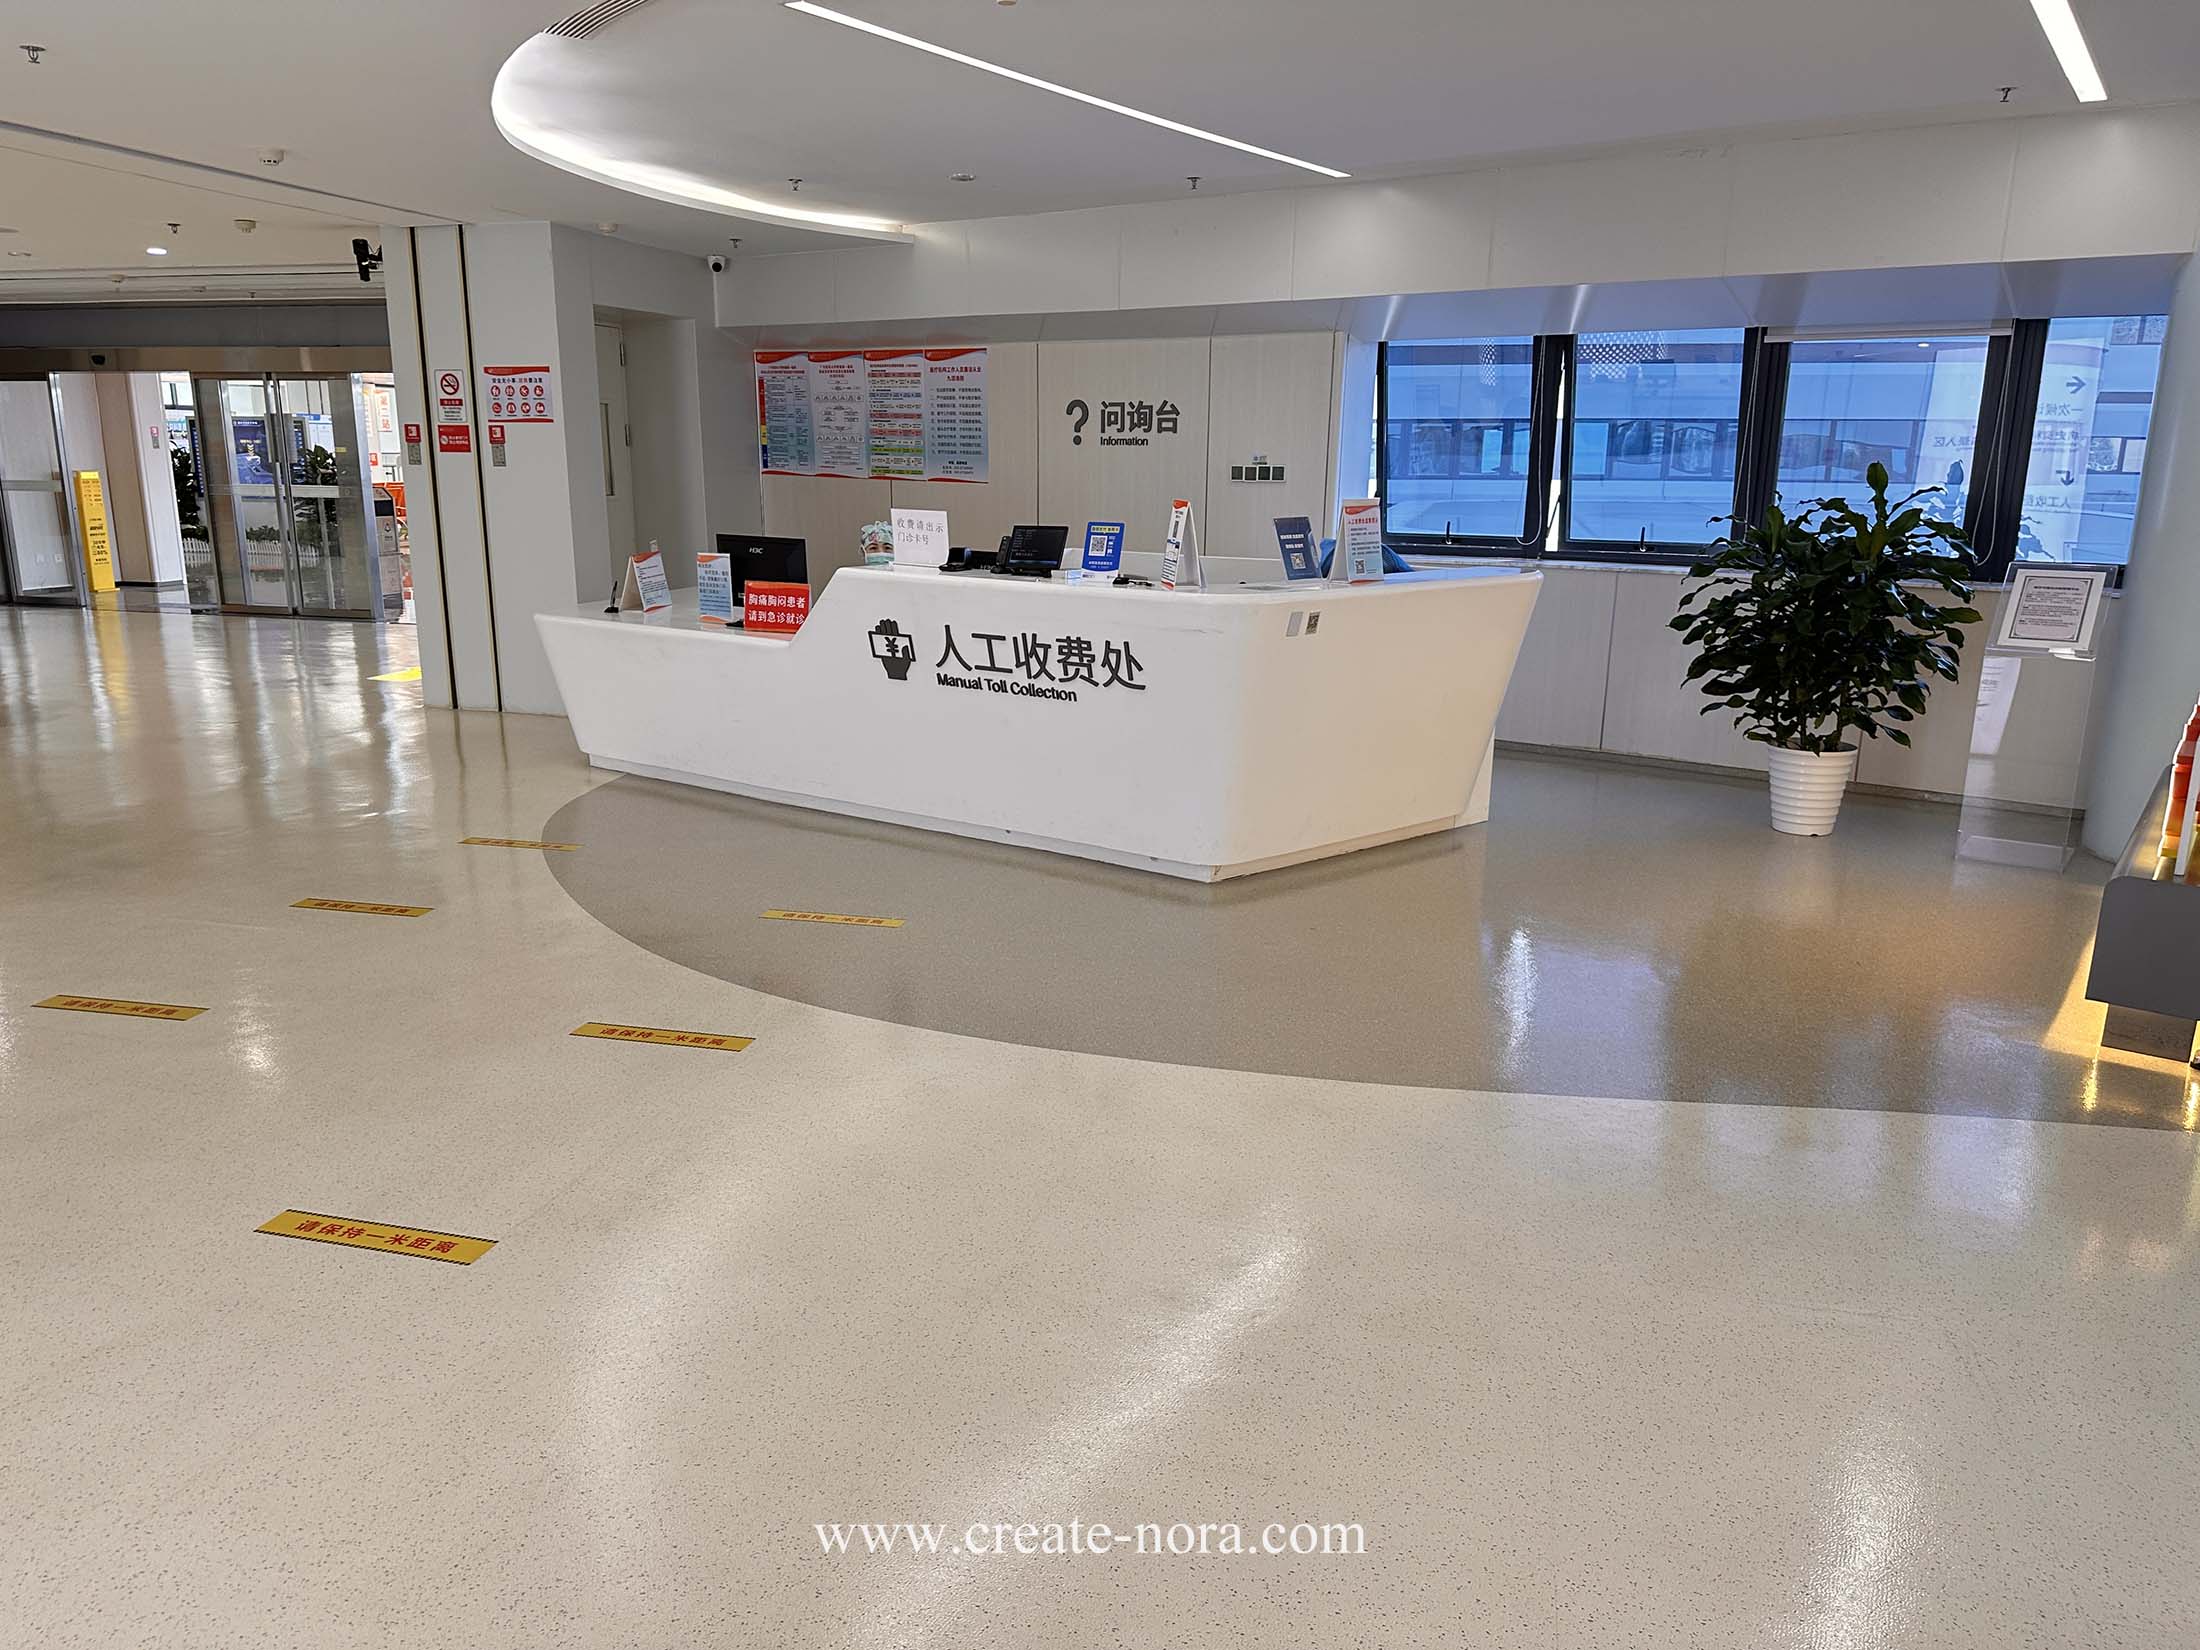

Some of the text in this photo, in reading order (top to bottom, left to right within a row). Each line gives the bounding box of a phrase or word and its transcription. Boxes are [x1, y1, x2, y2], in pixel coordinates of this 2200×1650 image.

[1100, 400, 1180, 434] 问询台
[1100, 436, 1149, 446] Information
[748, 593, 806, 609] 胸痛胸闷患者
[748, 609, 806, 625] 请到急诊就诊
[935, 624, 1146, 691] 人工收费处
[936, 672, 1078, 702] Manual Toll Collection
[600, 1027, 727, 1046] 请保持一米距离
[294, 1219, 458, 1254] 请保持一米距离
